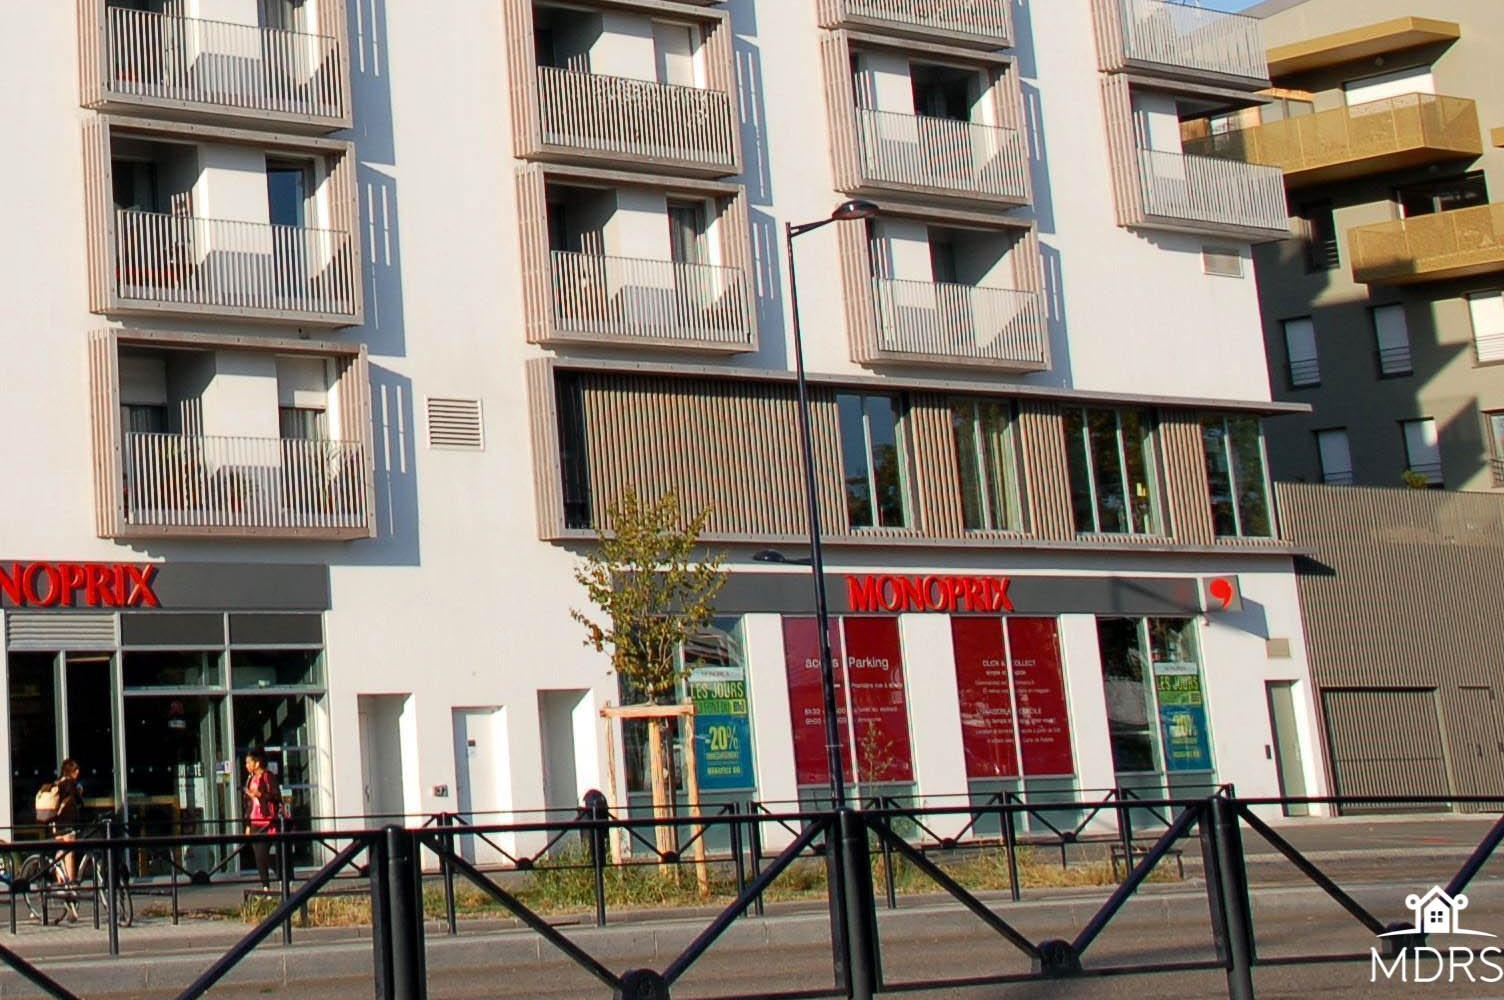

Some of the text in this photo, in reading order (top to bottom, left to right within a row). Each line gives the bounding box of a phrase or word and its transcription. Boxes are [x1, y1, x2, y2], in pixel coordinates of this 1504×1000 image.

[847, 575, 1015, 612] MONOPRIX
[848, 656, 890, 671] Parking
[691, 682, 744, 698] LES JOURS
[705, 722, 739, 751] -20%
